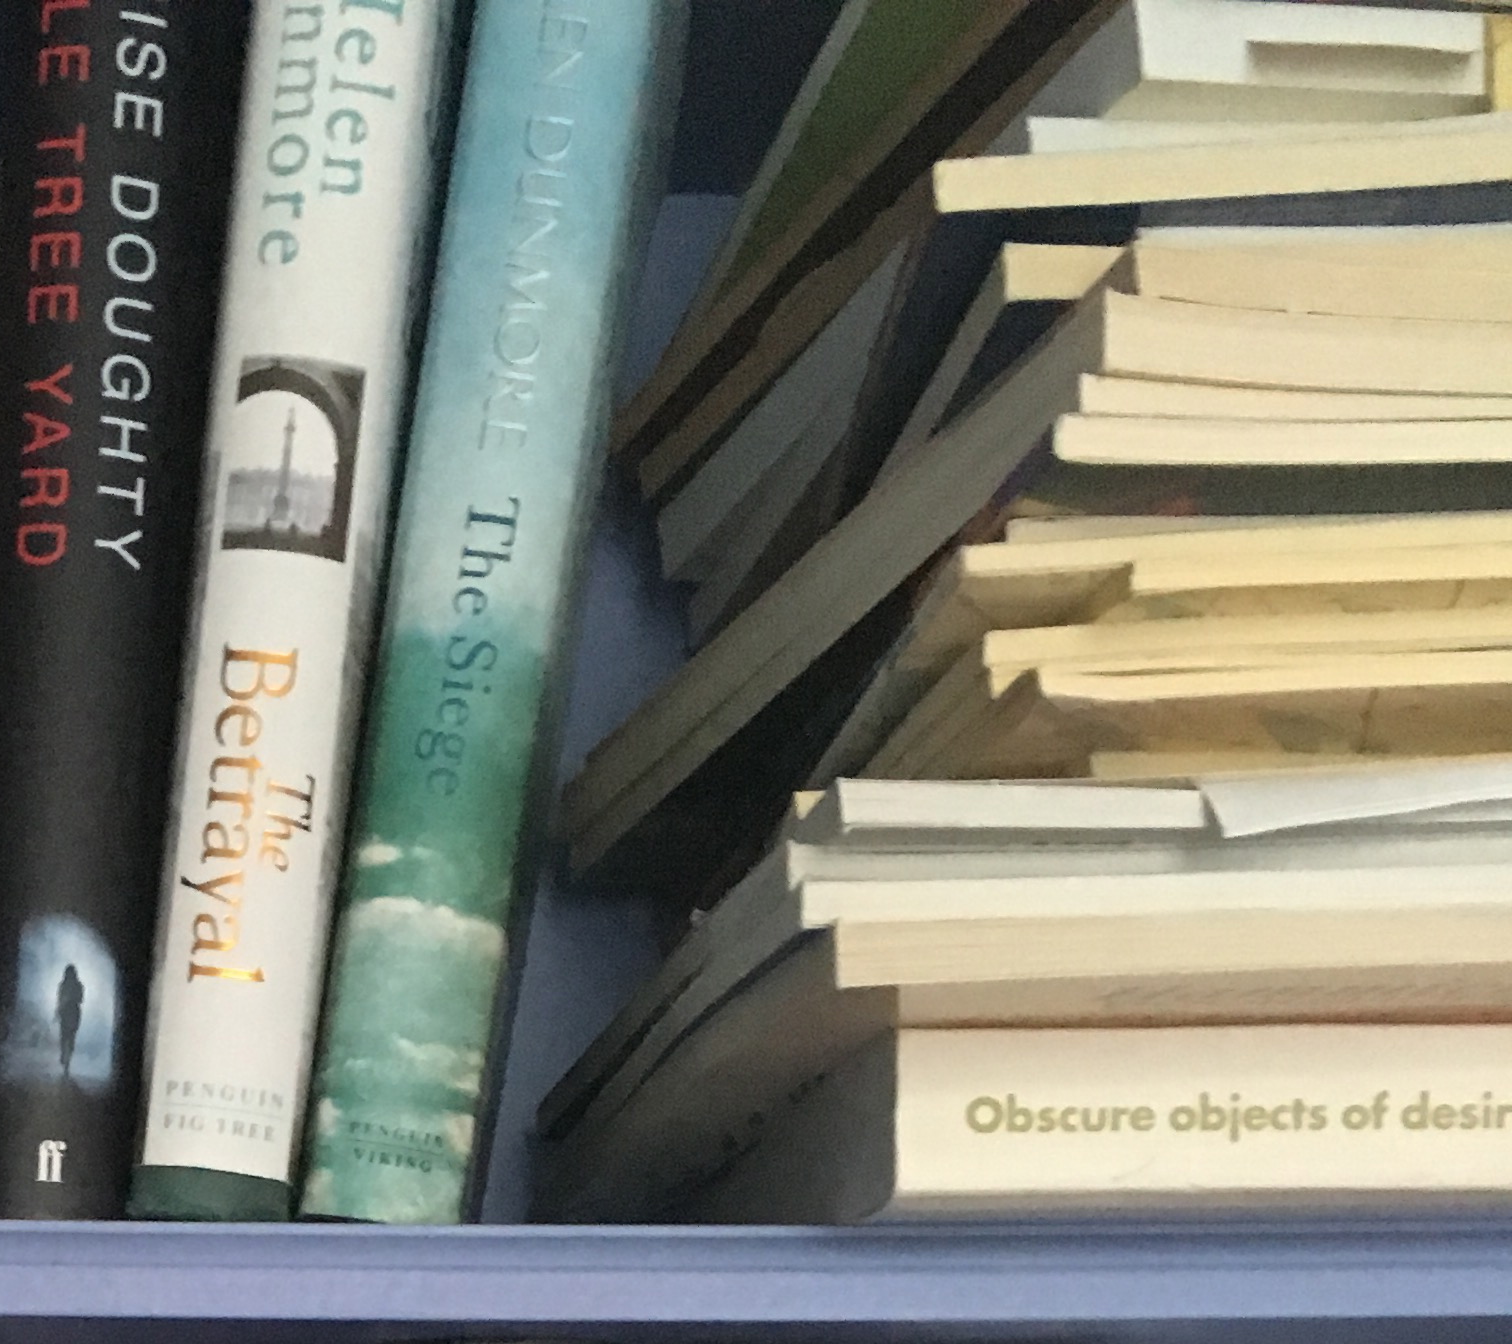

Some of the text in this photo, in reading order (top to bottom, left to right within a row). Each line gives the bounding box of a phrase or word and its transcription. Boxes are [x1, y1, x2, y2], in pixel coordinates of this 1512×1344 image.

[93, 175, 160, 571] DOUGHTY
[413, 497, 521, 798] The Siege
[179, 642, 299, 984] Betrayal
[255, 775, 317, 872] The
[965, 1089, 1390, 1143] Obscure objects of
